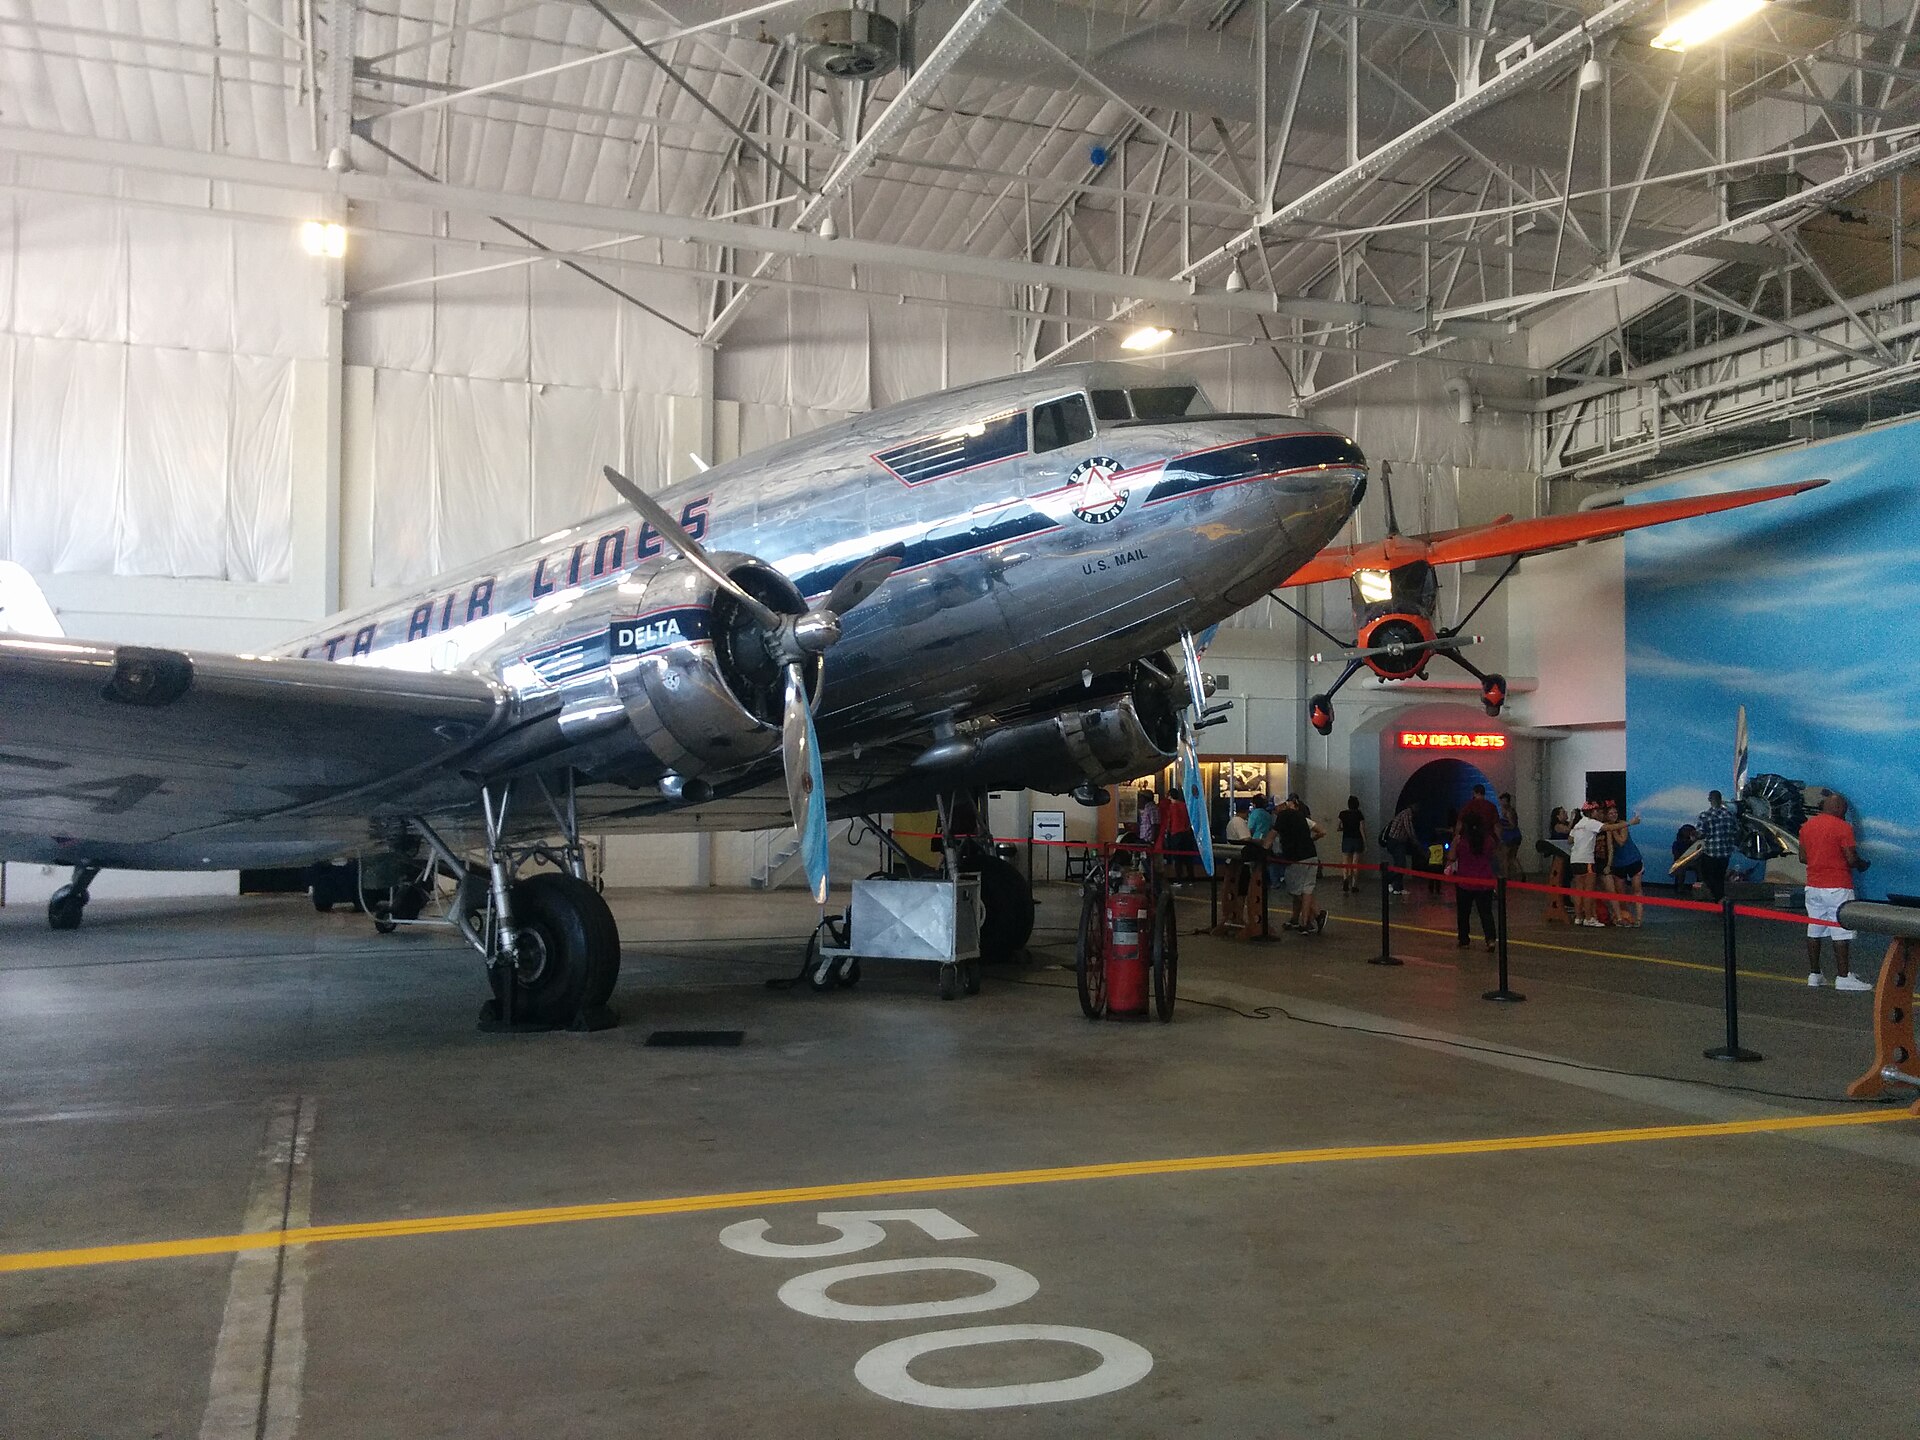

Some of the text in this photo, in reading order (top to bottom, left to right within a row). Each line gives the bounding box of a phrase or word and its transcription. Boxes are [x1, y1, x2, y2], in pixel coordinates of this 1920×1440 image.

[1069, 457, 1119, 482] DELTA
[1097, 489, 1130, 523] LINES
[1114, 548, 1149, 567] MAIL
[406, 576, 498, 643] AIR
[618, 618, 681, 647] DELTA
[1402, 733, 1505, 747] FLY DELTA JETS
[719, 1208, 1154, 1410] 500
